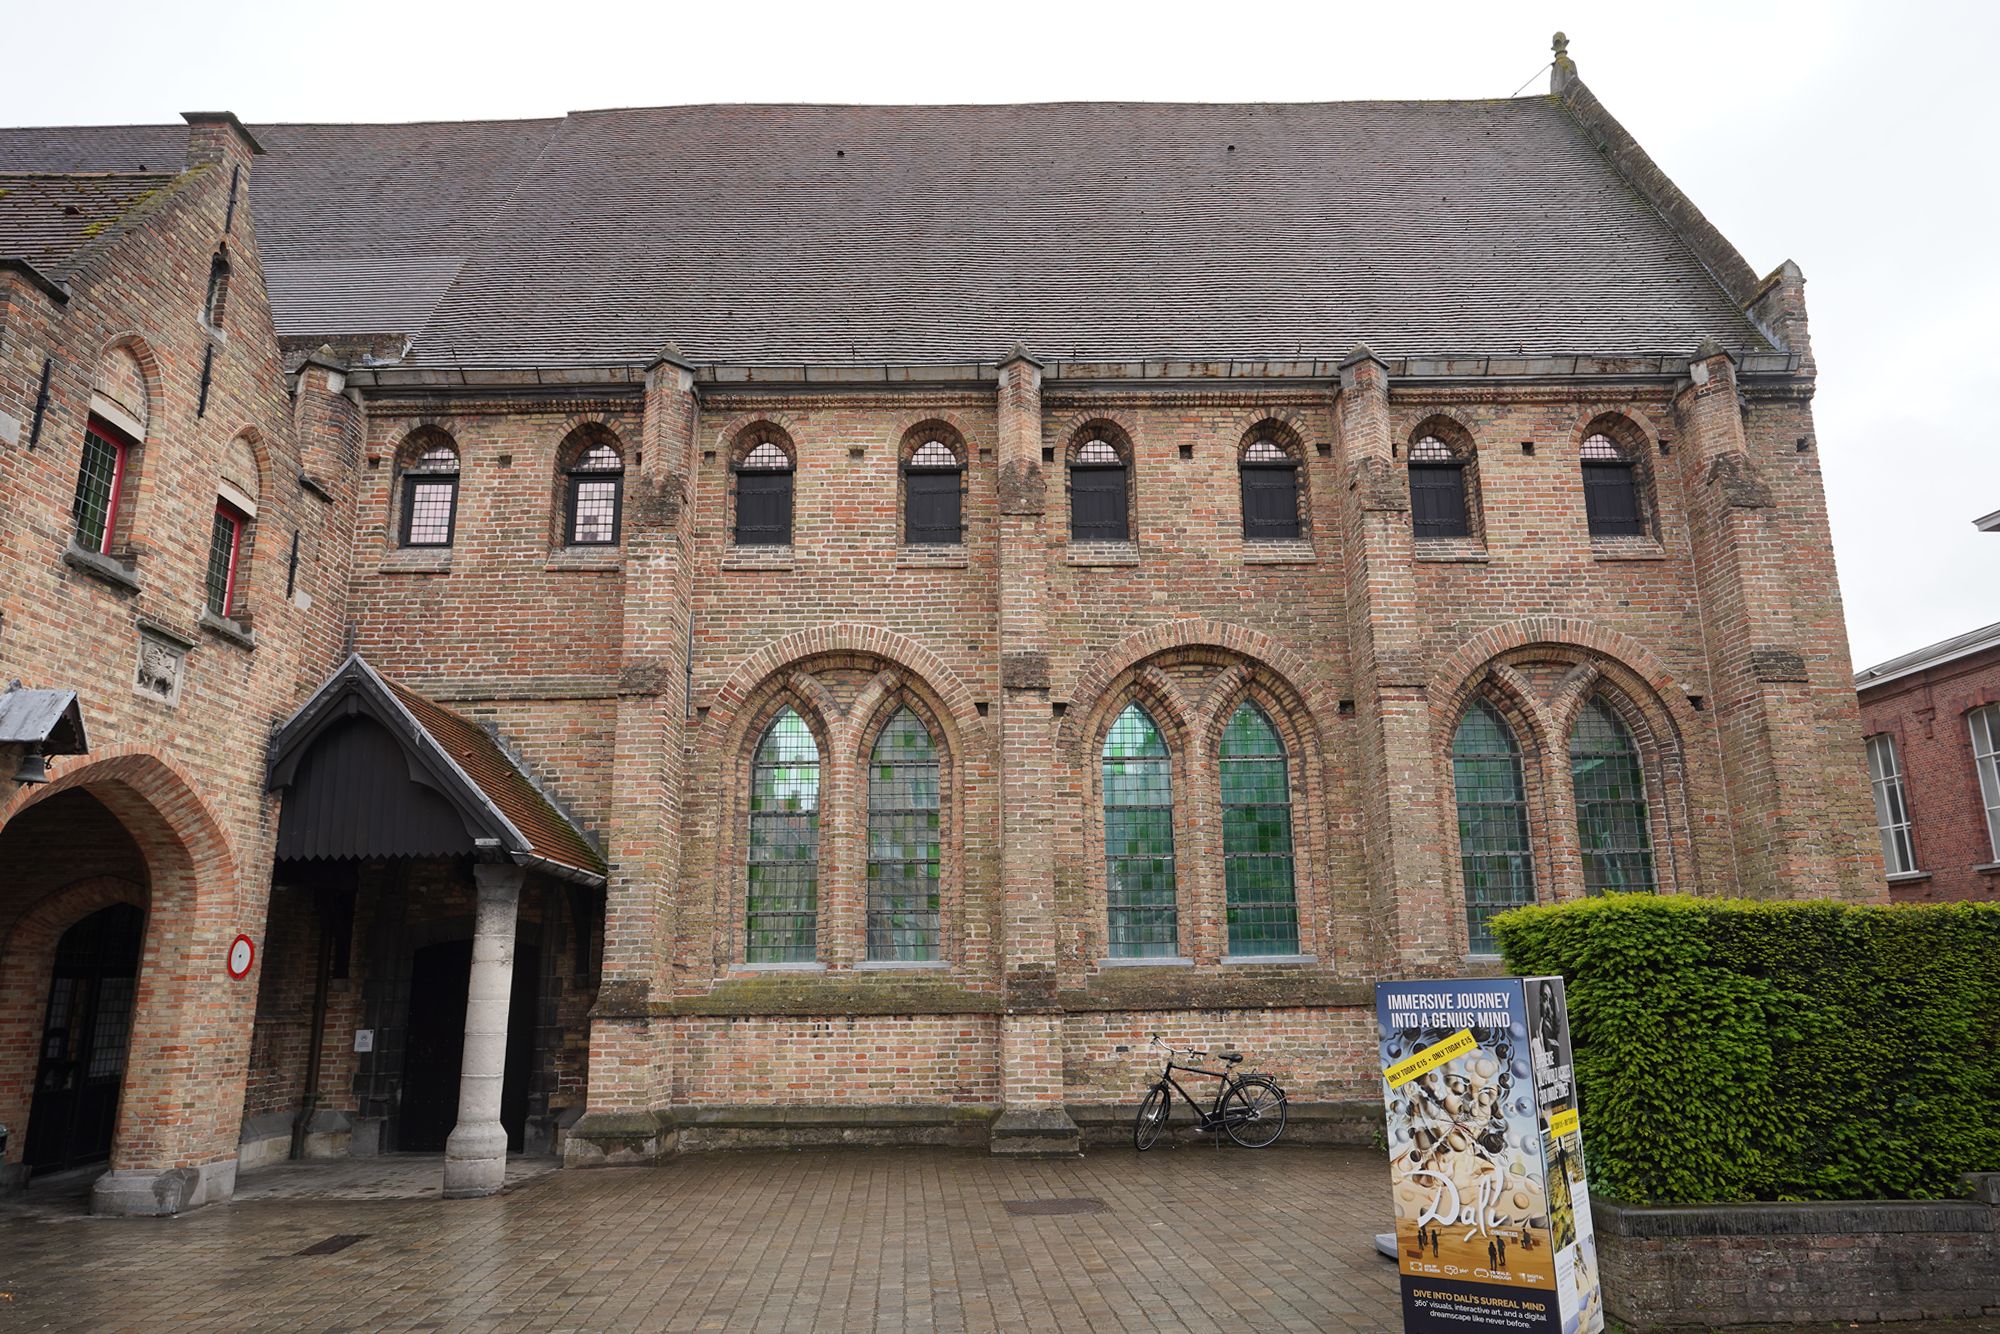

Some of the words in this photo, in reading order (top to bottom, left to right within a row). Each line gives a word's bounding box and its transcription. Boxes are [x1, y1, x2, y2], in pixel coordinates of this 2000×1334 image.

[1388, 993, 1454, 1010] IMMERSIVE
[1457, 993, 1510, 1009] JOURNEY
[1391, 1013, 1418, 1028] INTO
[1421, 1013, 1429, 1028] A
[1432, 1012, 1475, 1028] GENIUS
[1478, 1012, 1510, 1028] MIND
[1388, 1072, 1401, 1082] ONLY
[1401, 1065, 1417, 1076] TODAY
[1432, 1050, 1445, 1060] ONLY
[1445, 1042, 1461, 1054] TODAY
[1413, 1290, 1432, 1298] DIVE
[1433, 1292, 1452, 1300] INTO
[1481, 1297, 1519, 1309] SURREAL
[1522, 1302, 1545, 1312] MIND
[1429, 1302, 1453, 1310] visuals,
[1454, 1304, 1490, 1315] interactive
[1504, 1310, 1516, 1318] and
[1524, 1312, 1547, 1322] digital
[1430, 1310, 1471, 1322] dreamscape
[1472, 1315, 1484, 1323] like
[1485, 1318, 1505, 1326] never
[1506, 1318, 1531, 1329] before.
